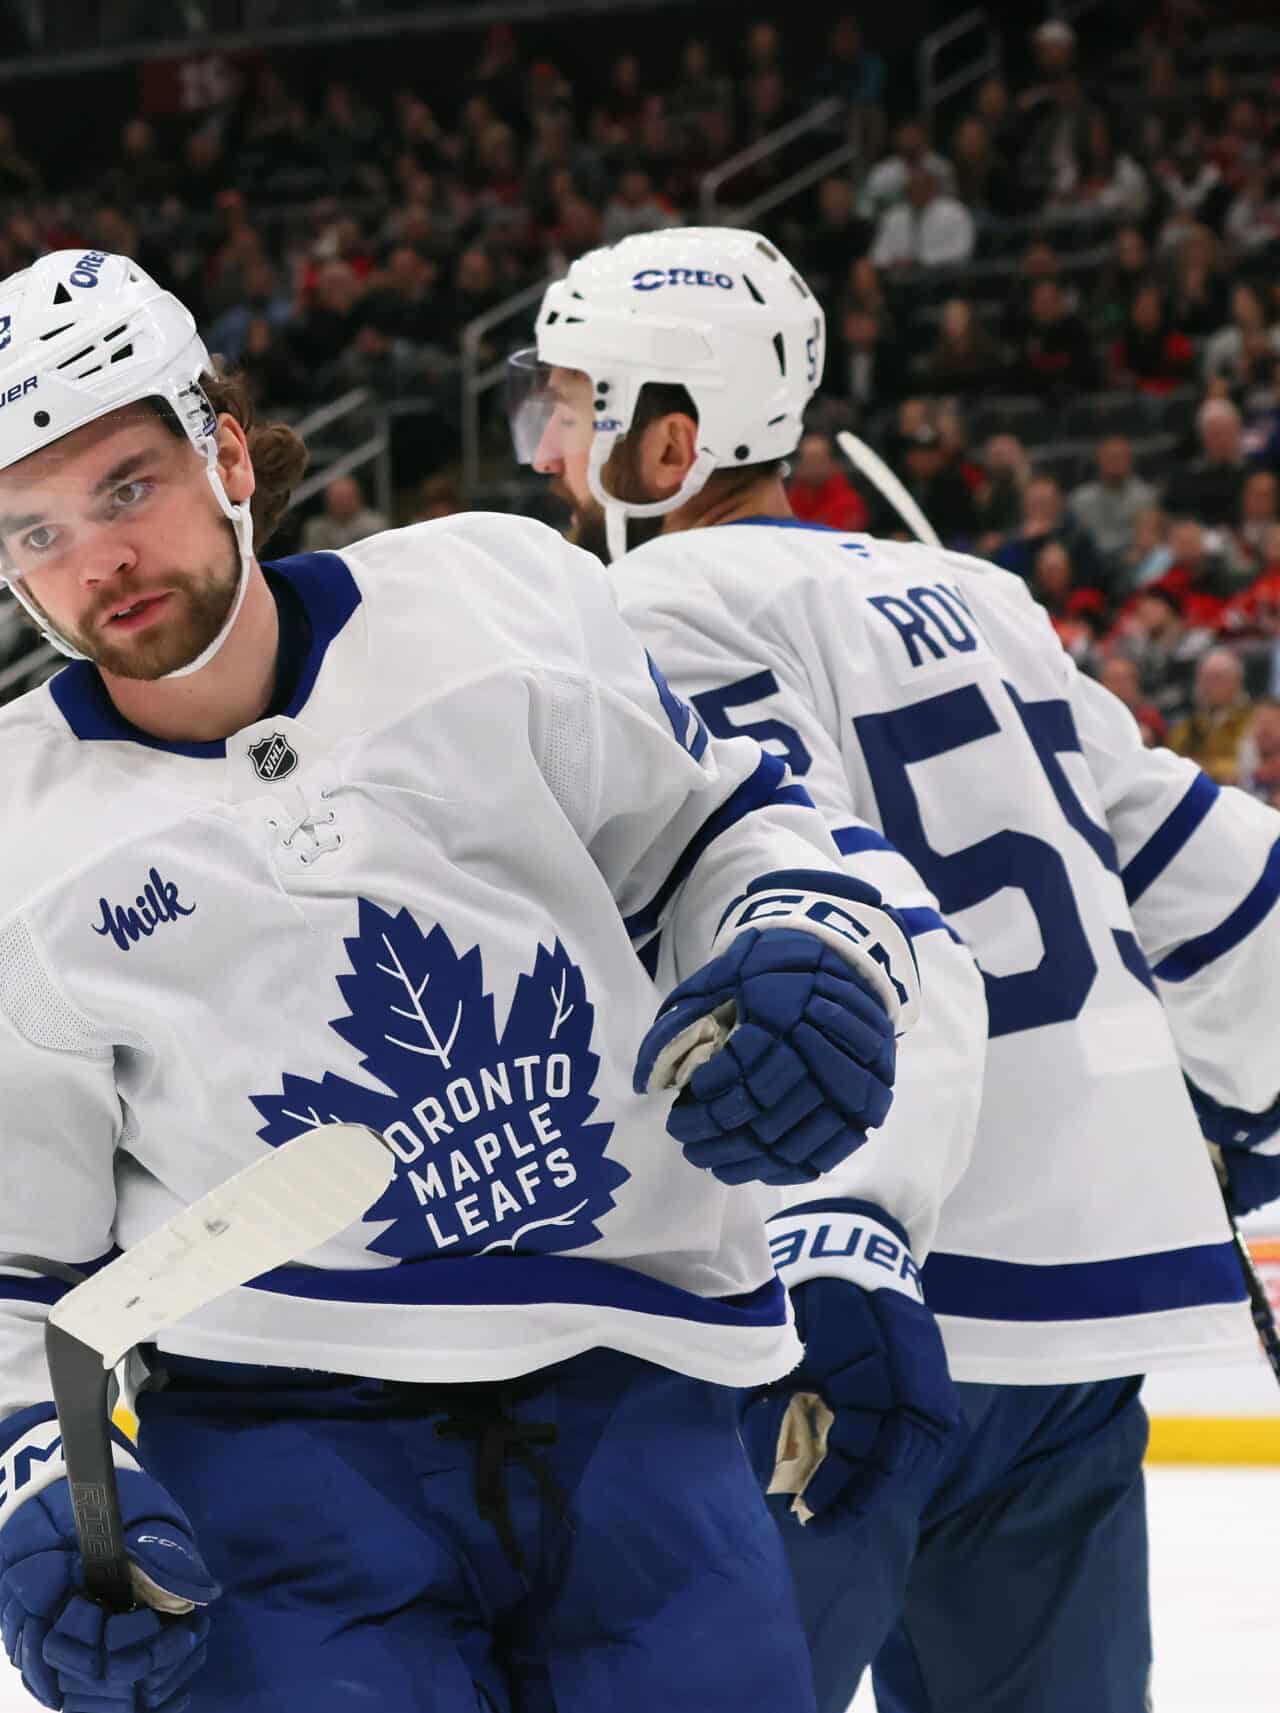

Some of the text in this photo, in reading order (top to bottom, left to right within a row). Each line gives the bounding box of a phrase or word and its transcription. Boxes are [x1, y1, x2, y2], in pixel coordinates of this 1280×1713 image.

[263, 743, 284, 777] NHL
[91, 867, 196, 951] Milk
[382, 1053, 571, 1165] ORONTO
[407, 1102, 562, 1207] MAPLE
[426, 1147, 577, 1249] LEAFS
[768, 1224, 924, 1299] AUER
